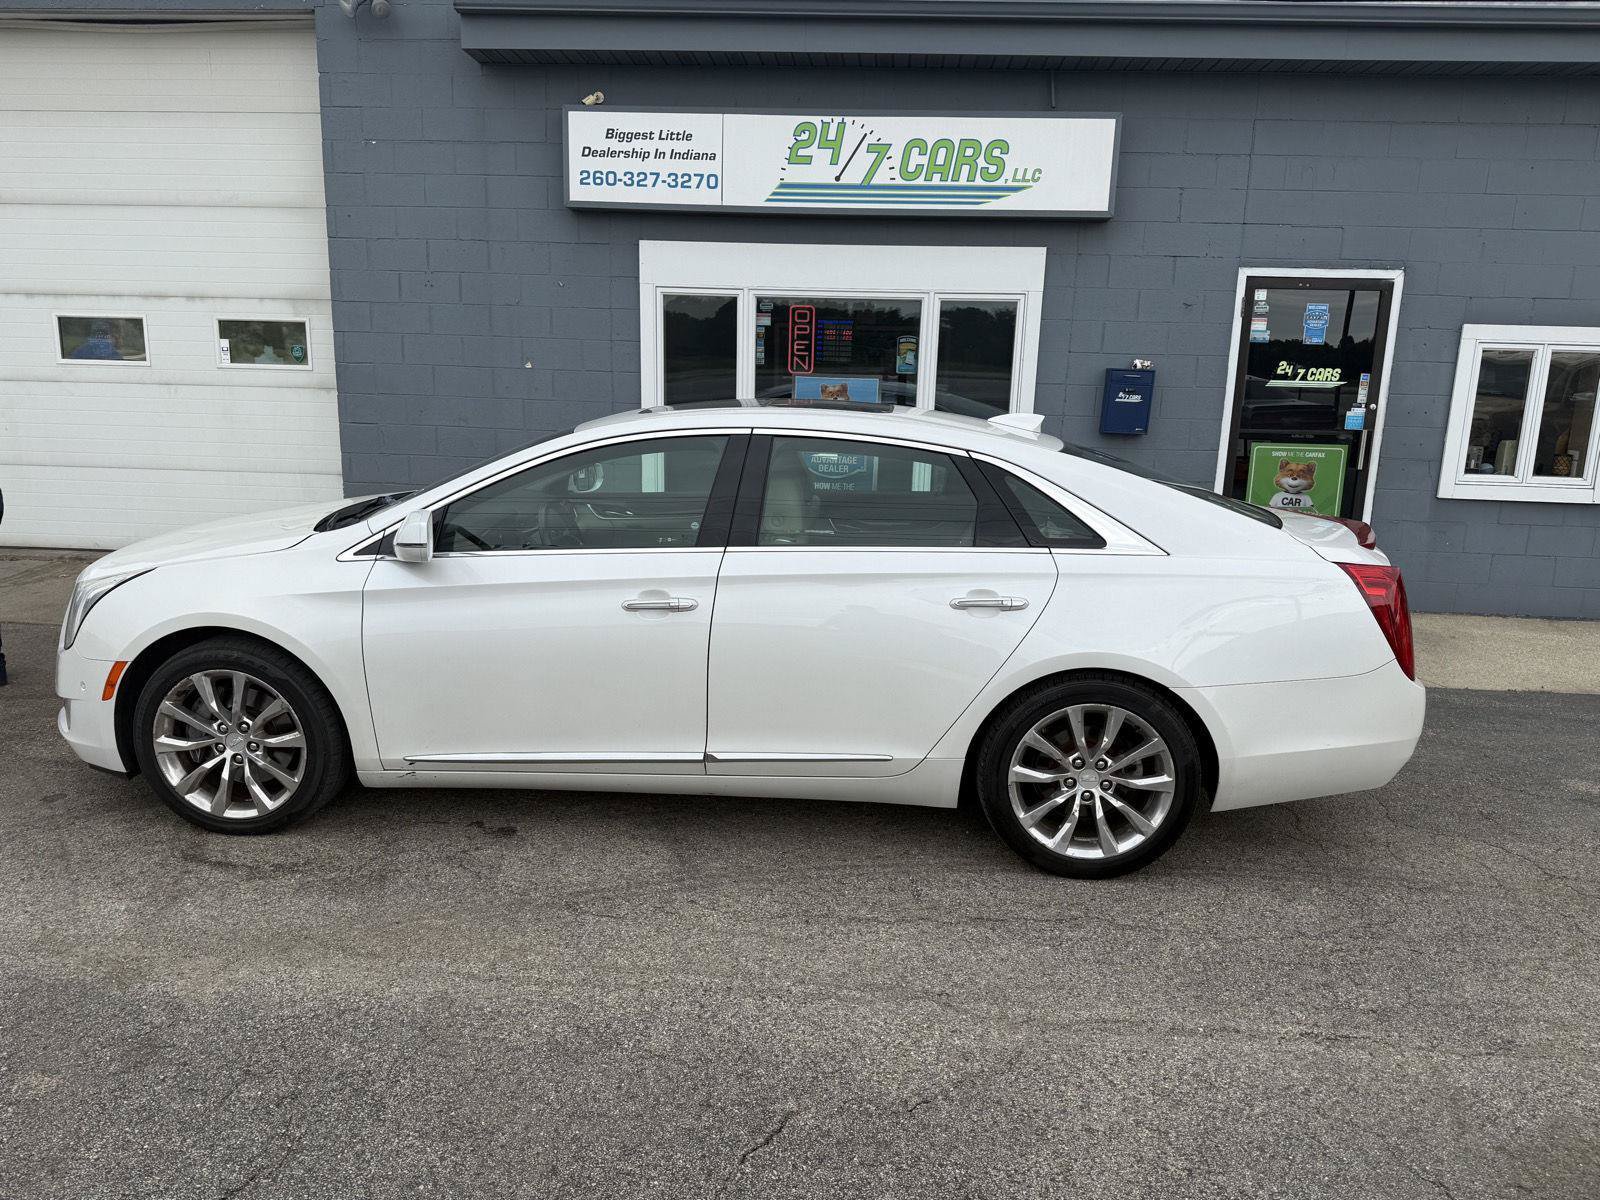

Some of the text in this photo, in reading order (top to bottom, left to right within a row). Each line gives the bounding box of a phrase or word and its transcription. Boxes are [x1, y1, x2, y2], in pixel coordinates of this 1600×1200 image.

[605, 128, 693, 143] Biggest Little
[581, 146, 717, 162] Dealership In Indiana
[579, 170, 719, 190] 260-327-3270
[1012, 167, 1043, 183] LLC
[793, 310, 809, 370] OPEN
[1306, 367, 1342, 382] CARS
[810, 455, 858, 465] ADVANTAGE
[818, 464, 849, 473] DEALER
[831, 482, 841, 490] ME
[842, 482, 855, 491] THE
[1281, 497, 1302, 507] CAR
